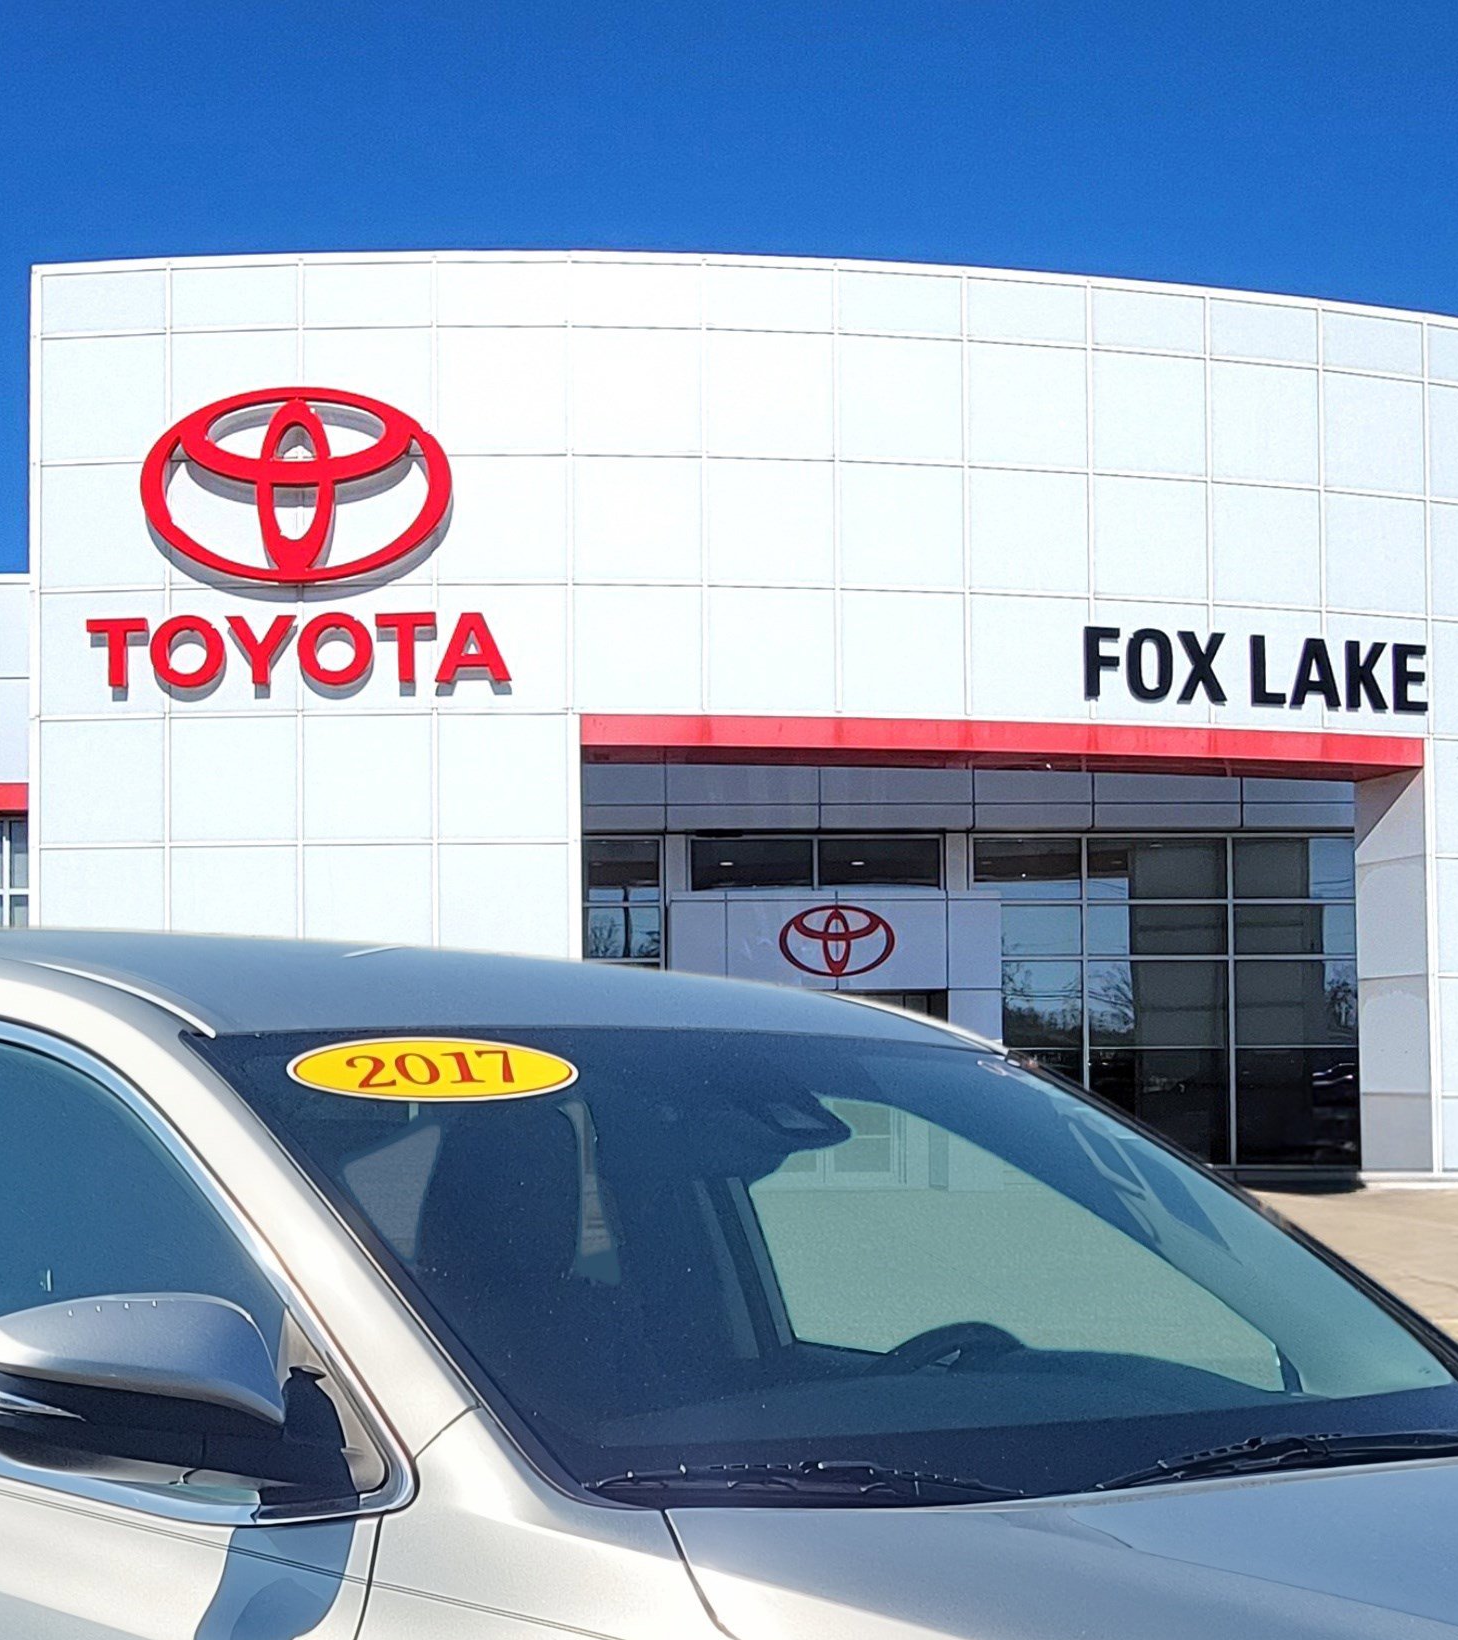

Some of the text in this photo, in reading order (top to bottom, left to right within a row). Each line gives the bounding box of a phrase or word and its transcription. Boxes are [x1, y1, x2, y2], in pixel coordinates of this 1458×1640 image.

[86, 611, 512, 690] TOYOTA
[1083, 626, 1428, 713] FOX LAKE
[345, 1050, 515, 1089] 2017
